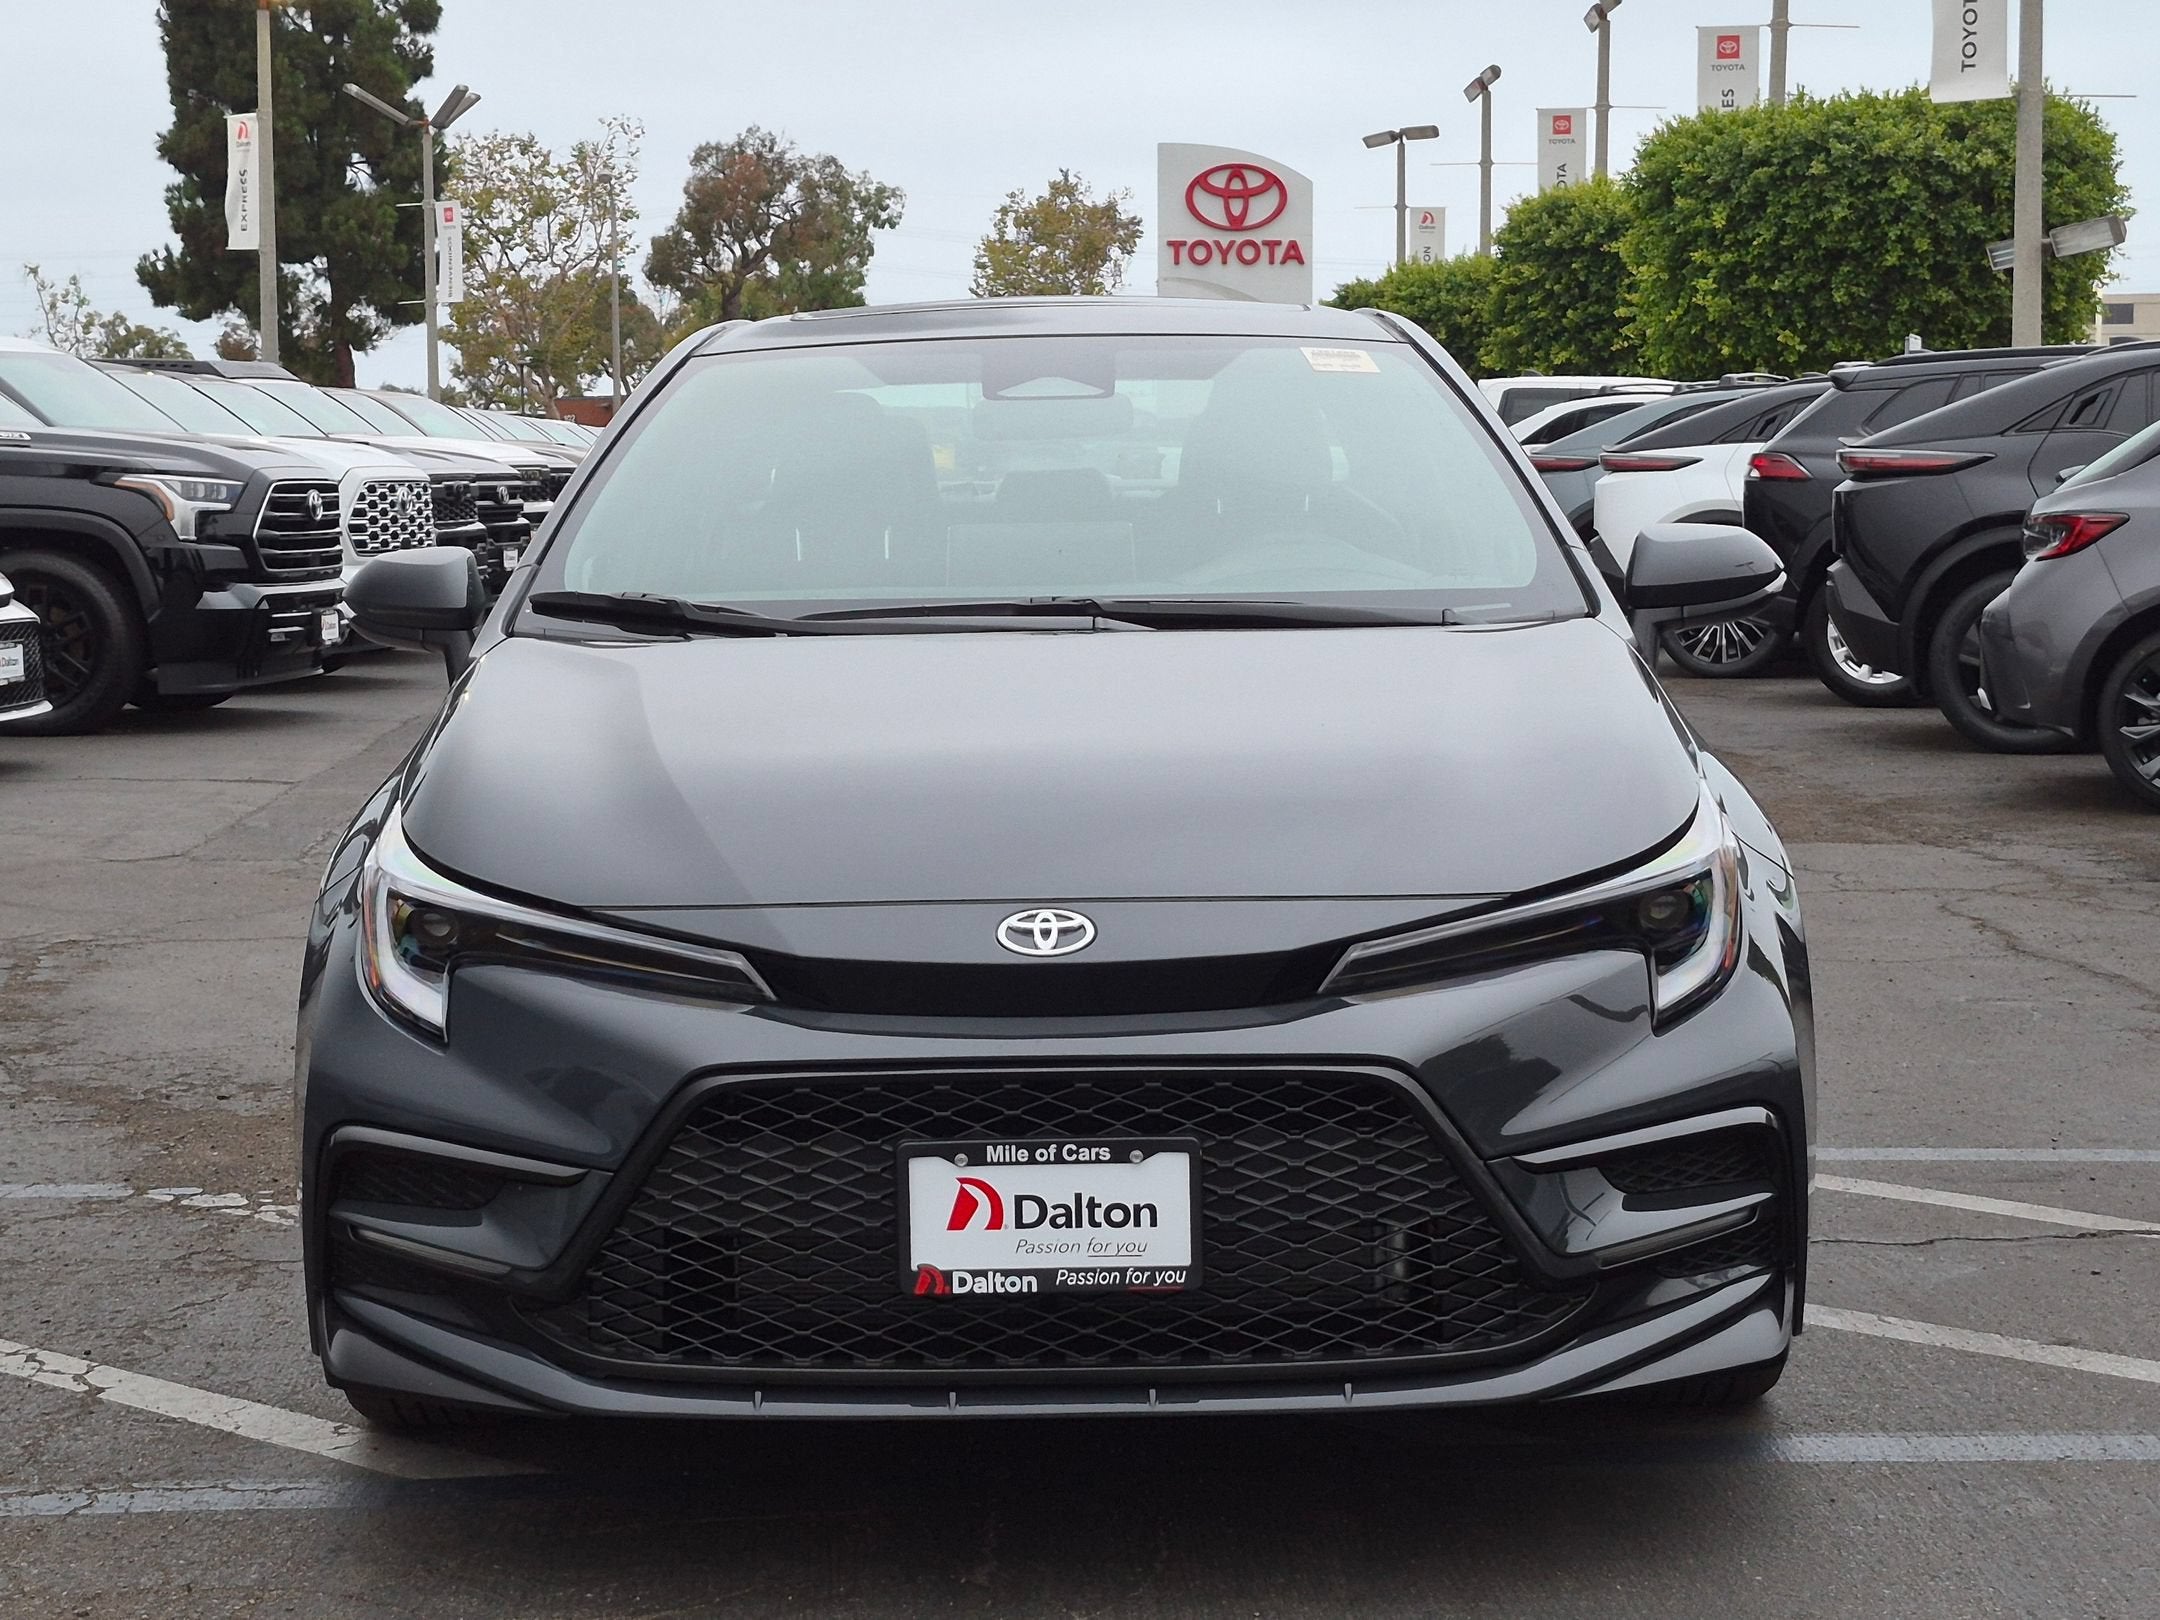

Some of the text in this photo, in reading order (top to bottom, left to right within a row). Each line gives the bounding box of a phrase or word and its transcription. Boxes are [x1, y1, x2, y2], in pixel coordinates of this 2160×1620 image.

[1711, 64, 1746, 72] TOYOTA
[239, 168, 248, 232] EXPRESS
[1166, 239, 1305, 266] TOYOTA
[986, 1143, 1111, 1163] Mile of Cars
[1013, 1192, 1158, 1230] Dalton
[1015, 1237, 1148, 1256] Passion for you
[952, 1271, 1038, 1295] Dalton
[1056, 1267, 1187, 1287] Passion for you
